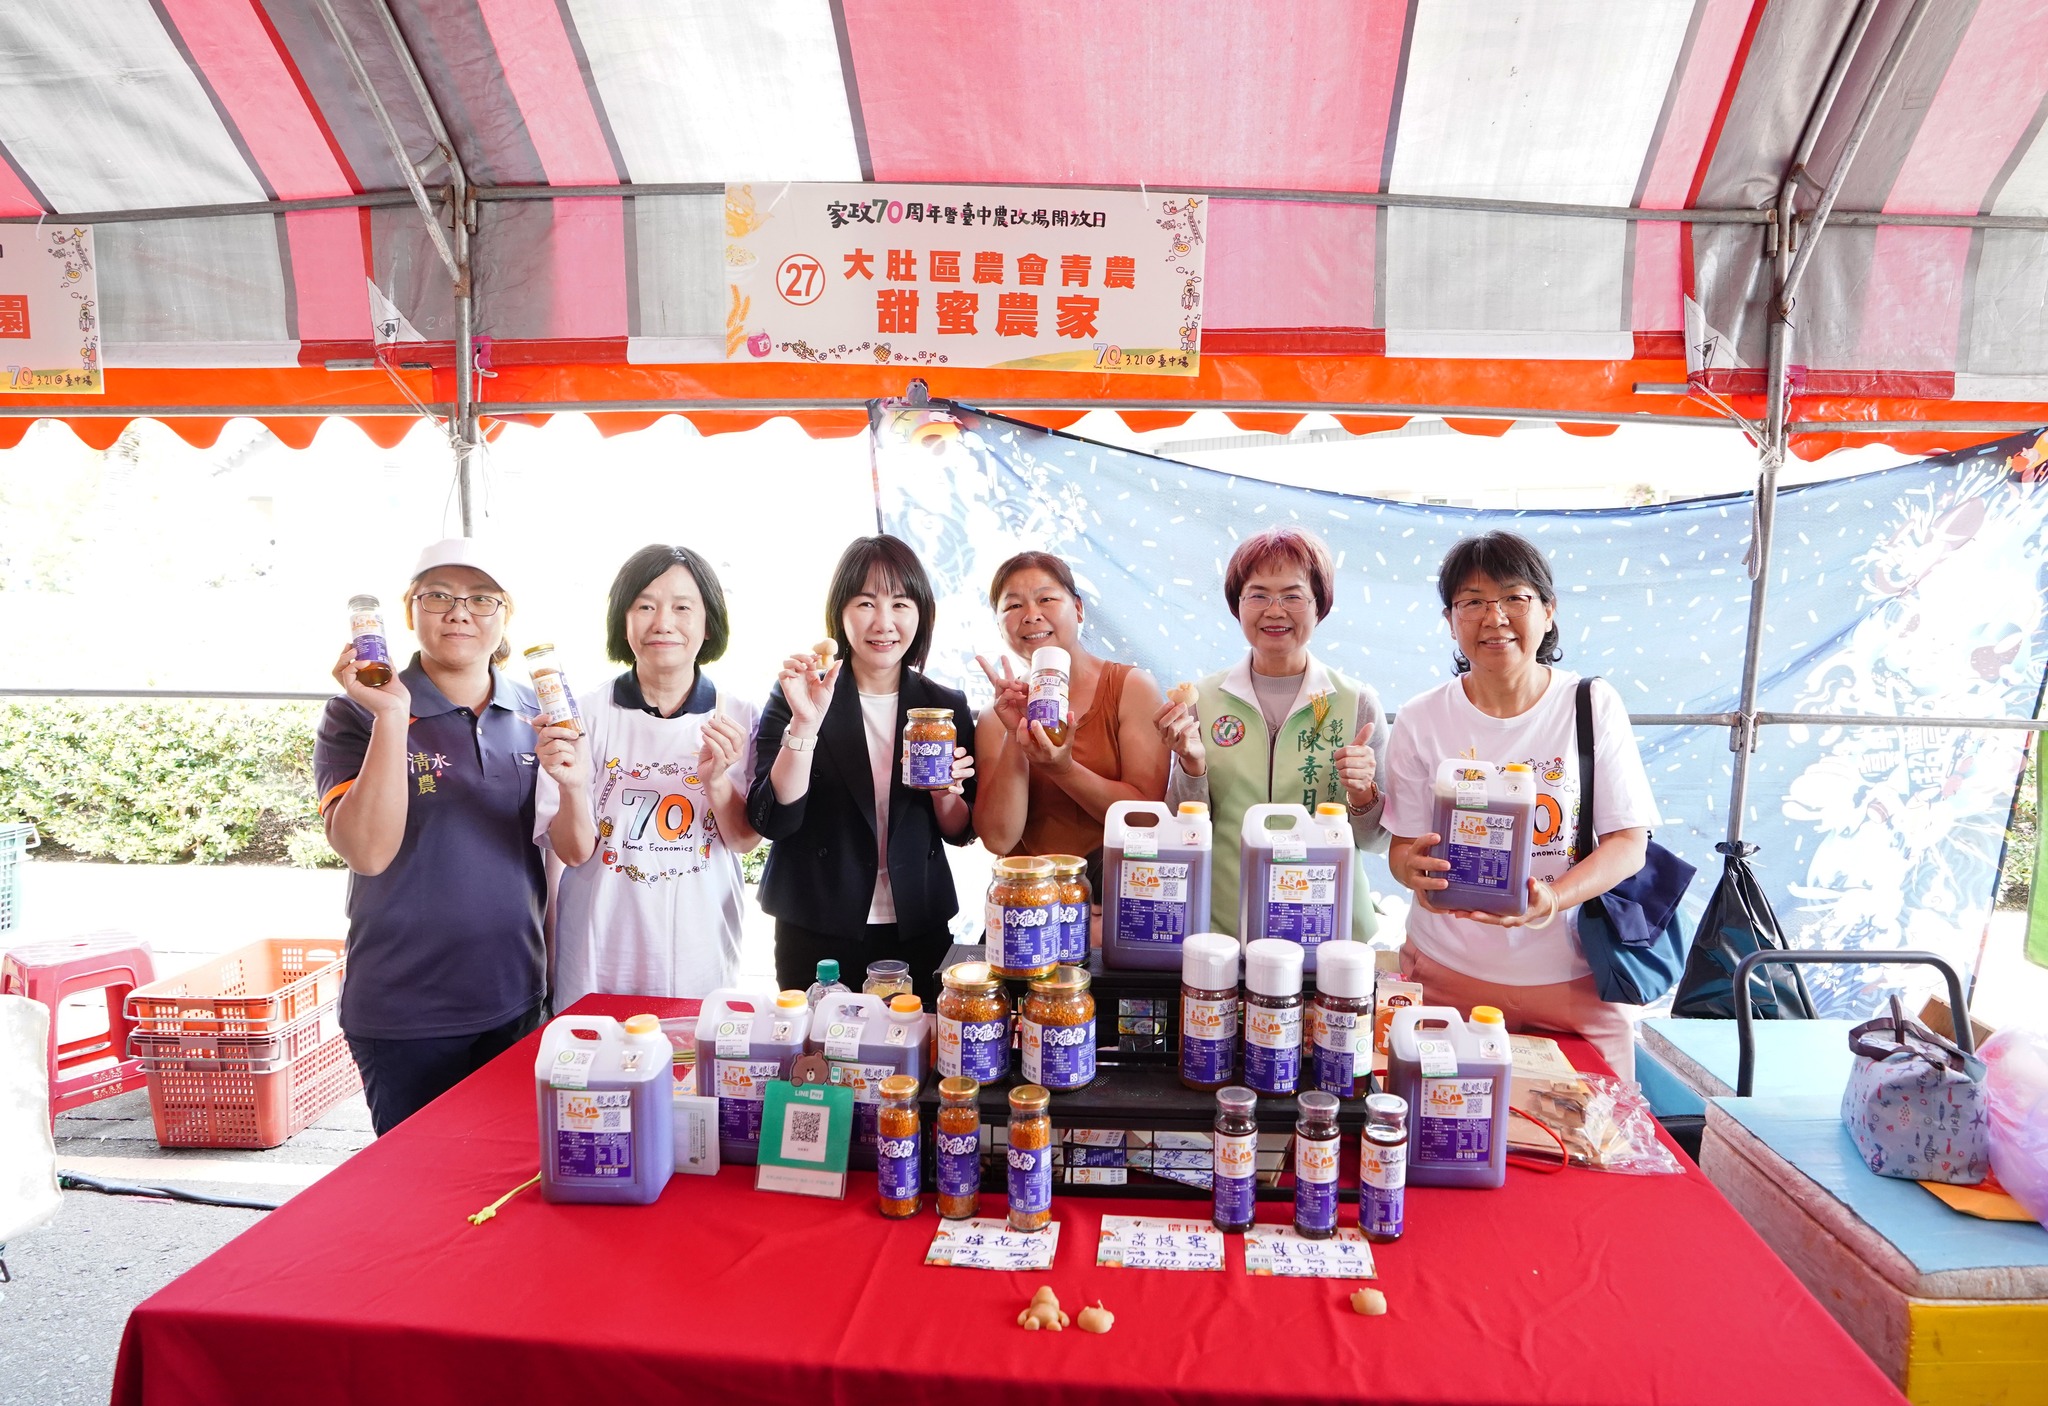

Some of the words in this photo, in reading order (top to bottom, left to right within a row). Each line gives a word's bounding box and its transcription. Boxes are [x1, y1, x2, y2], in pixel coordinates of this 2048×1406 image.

[826, 199, 1107, 229] 家政70周年暨臺中農改場開放日
[785, 263, 818, 296] 27
[843, 248, 1136, 290] 大肚區農會青農
[877, 288, 1100, 339] 甜蜜農家
[1298, 727, 1326, 815] 陳素月
[622, 840, 644, 852] Home
[648, 843, 694, 853] Economics
[1005, 909, 1049, 927] 蜂花粉
[963, 1022, 1005, 1042] 蜂花粉
[1043, 1028, 1087, 1047] 蜂花粉
[938, 1134, 978, 1155] 蜂花粉
[1008, 1148, 1036, 1171] 花粉
[1168, 1223, 1217, 1234] 價目表
